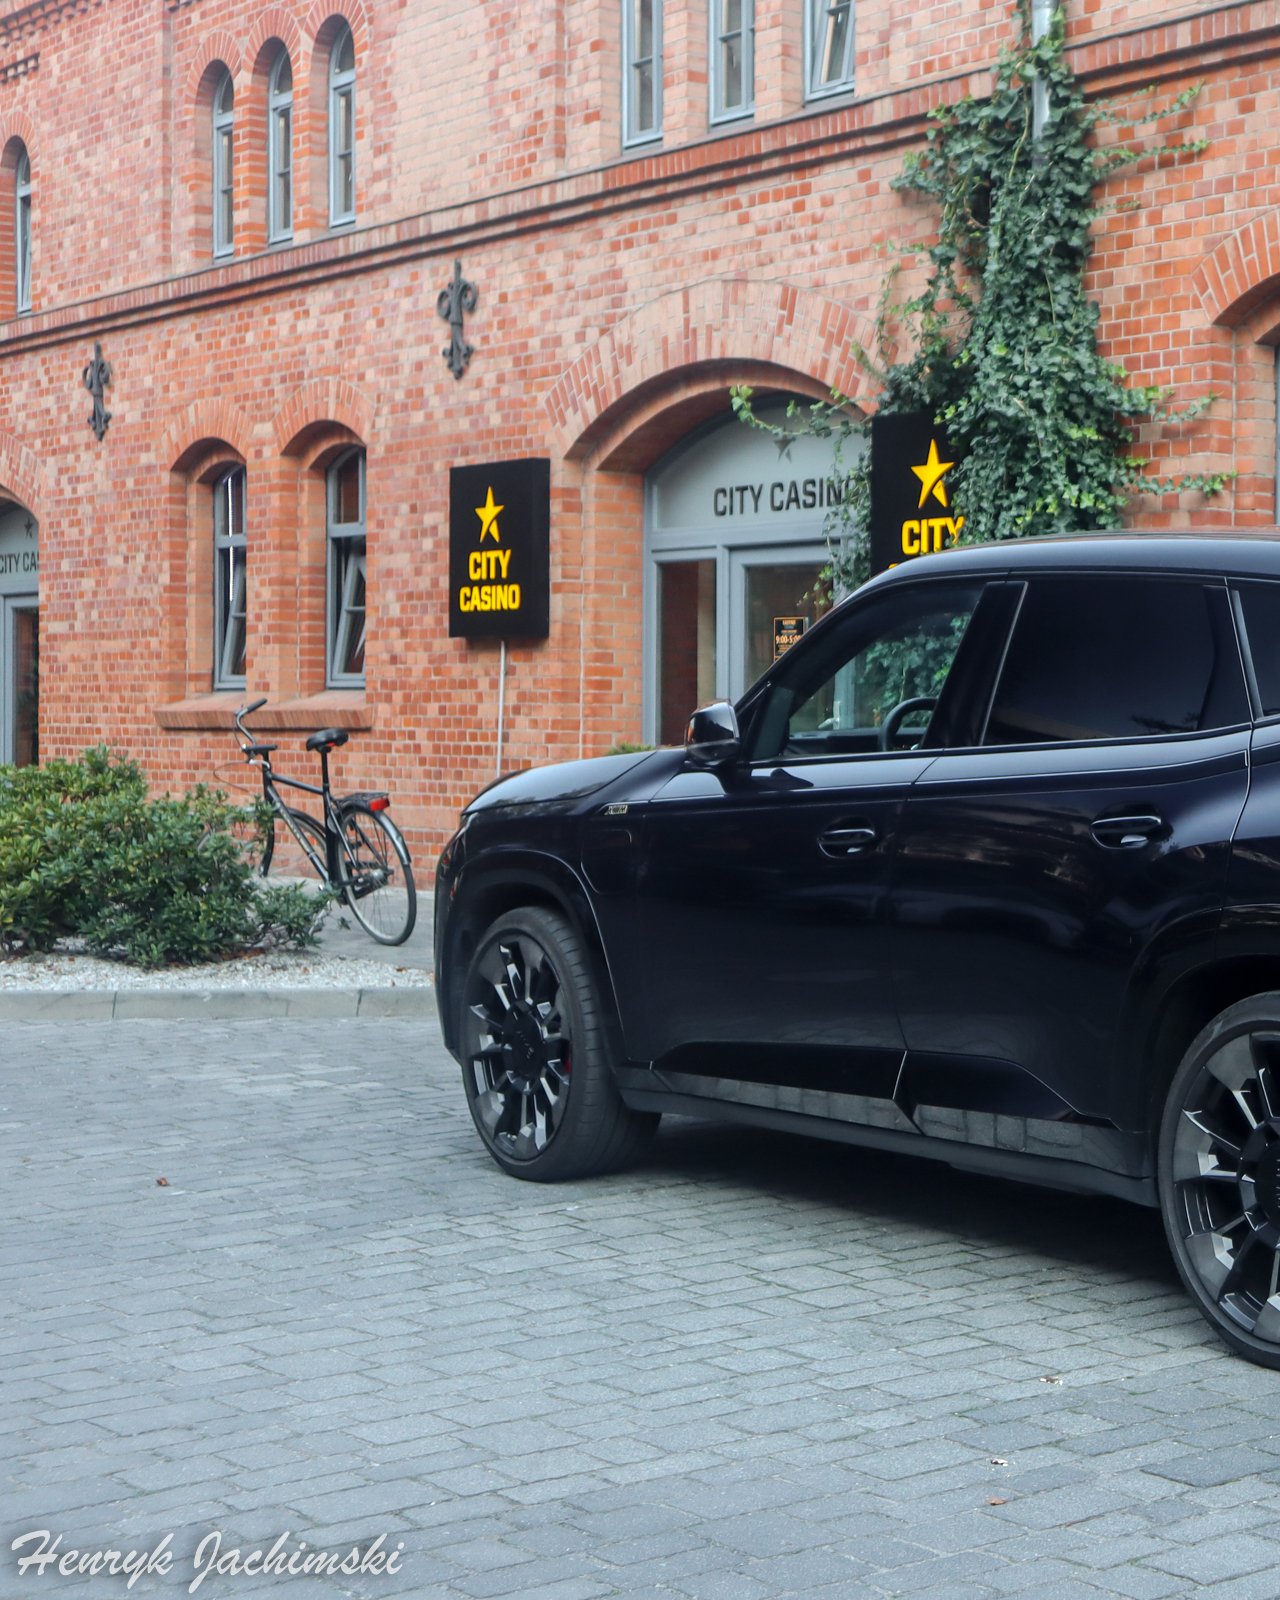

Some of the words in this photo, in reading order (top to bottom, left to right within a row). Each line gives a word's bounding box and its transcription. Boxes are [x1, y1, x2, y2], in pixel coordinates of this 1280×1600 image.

[714, 484, 763, 517] CITY
[902, 516, 965, 555] CITY
[468, 549, 512, 581] CITY
[459, 583, 521, 612] CASINO
